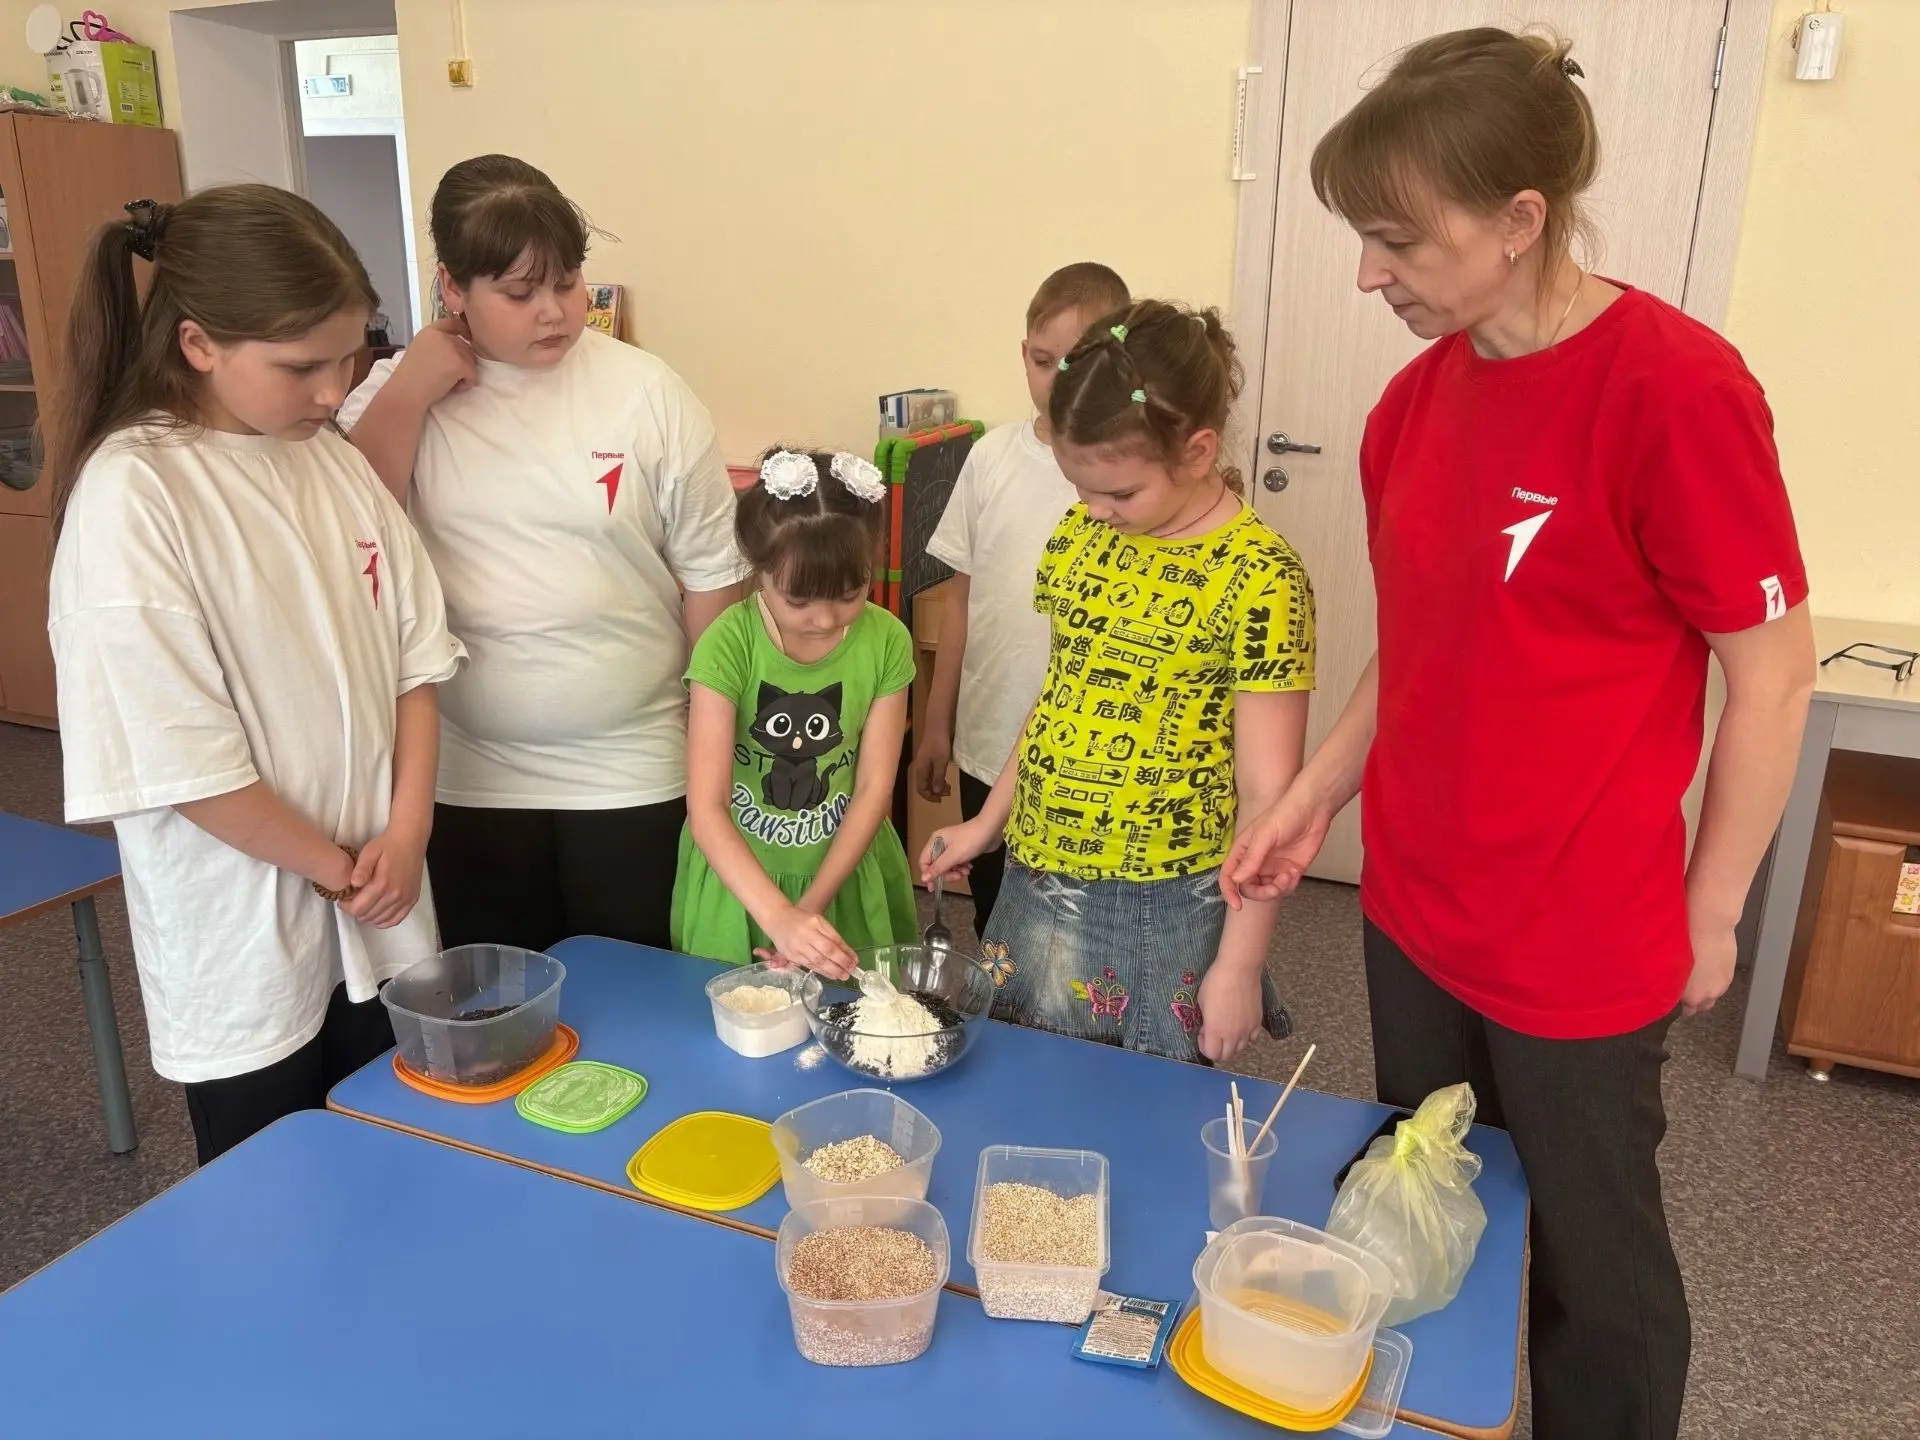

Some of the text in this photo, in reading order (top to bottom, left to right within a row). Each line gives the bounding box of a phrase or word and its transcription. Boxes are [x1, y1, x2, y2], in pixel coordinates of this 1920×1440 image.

[591, 451, 625, 461] Первые
[1511, 486, 1559, 506] Первые
[1157, 562, 1210, 592] 危険
[1068, 607, 1110, 636] 04
[1092, 699, 1143, 724] 危険
[1027, 743, 1057, 775] 04
[1056, 834, 1106, 856] 危険
